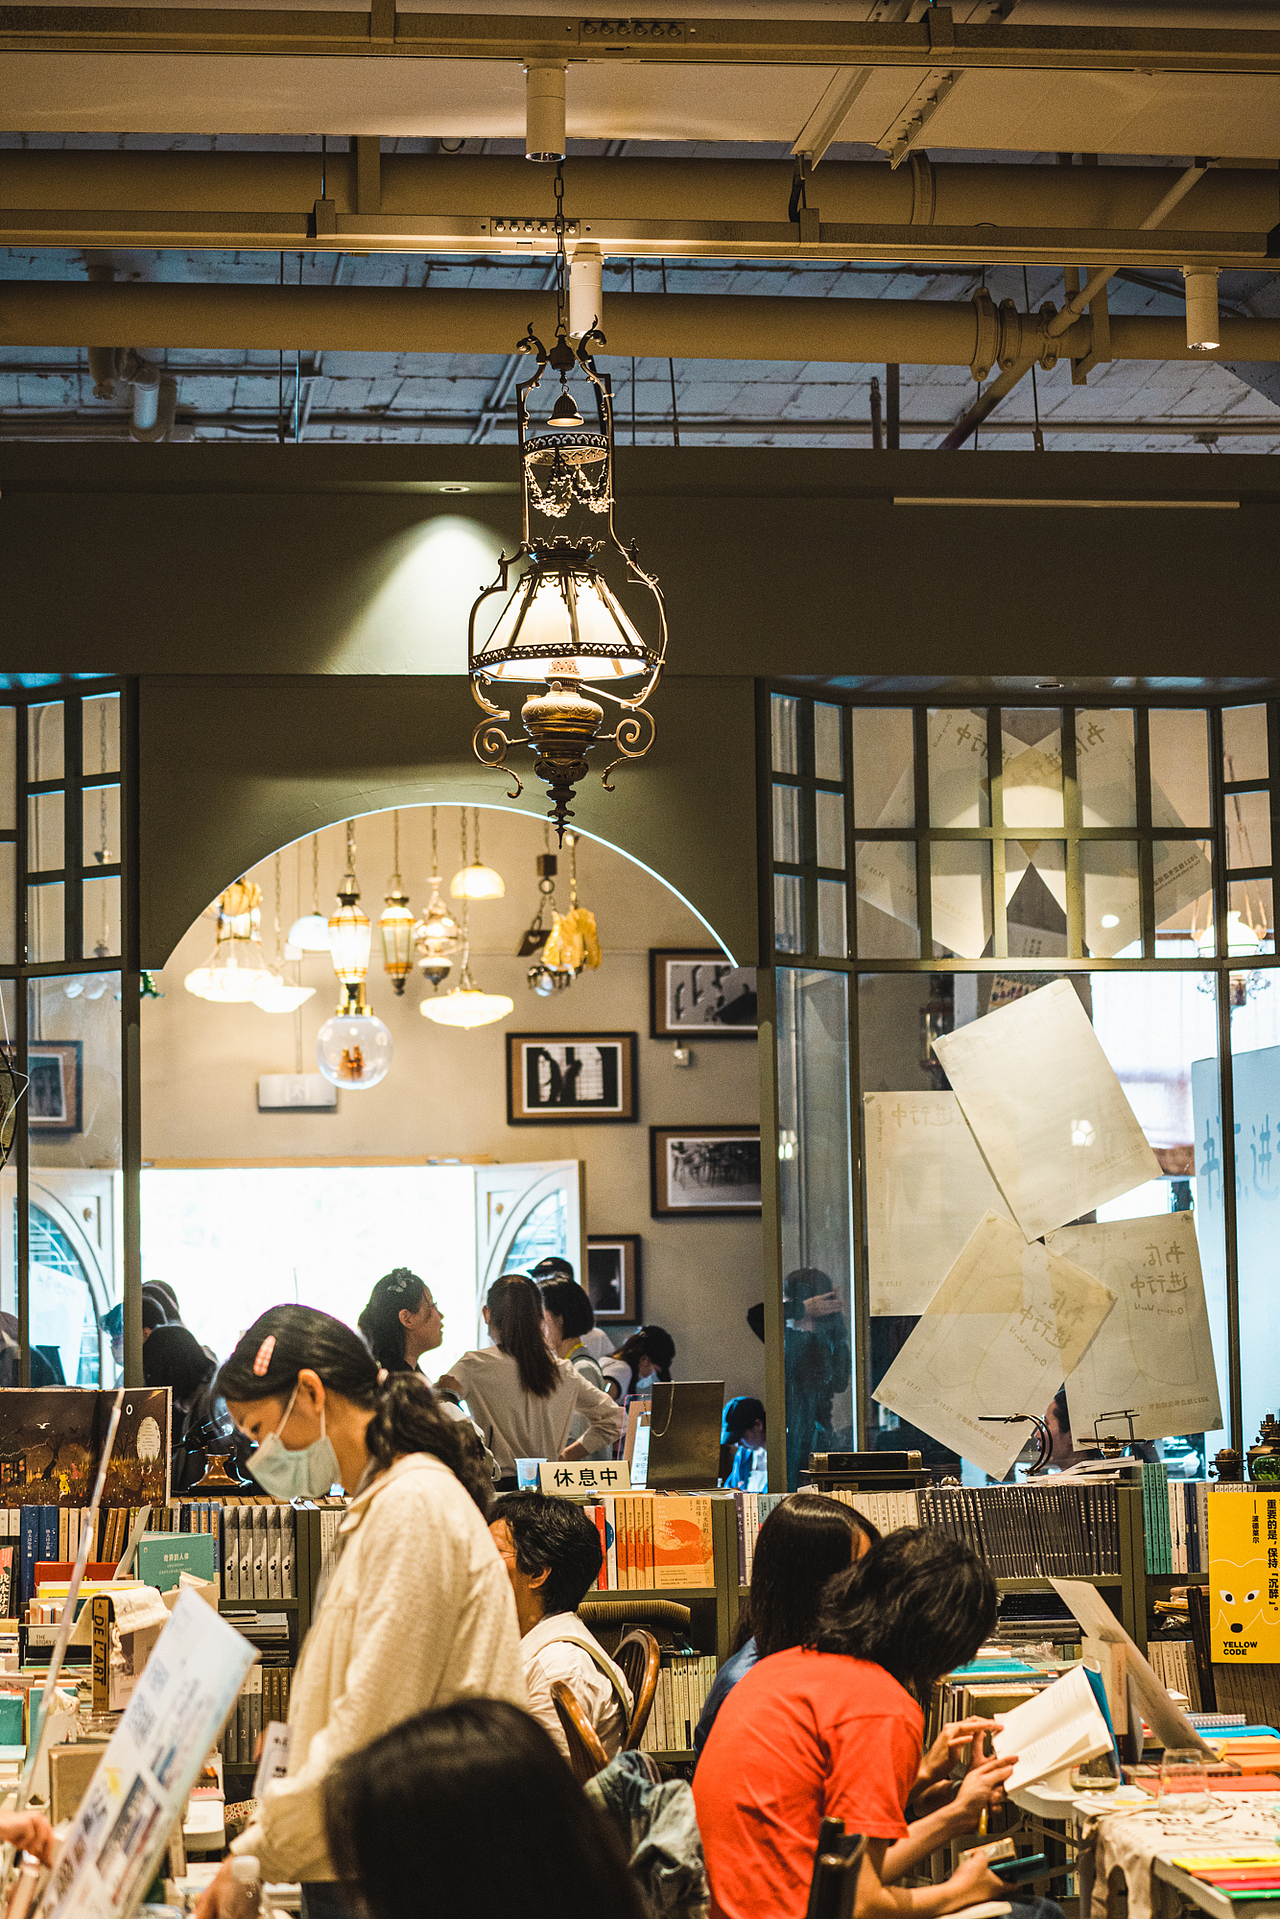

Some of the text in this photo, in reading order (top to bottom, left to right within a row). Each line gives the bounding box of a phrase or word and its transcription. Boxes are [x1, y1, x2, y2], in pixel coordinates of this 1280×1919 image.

[553, 1468, 618, 1487] 休息中
[94, 1615, 105, 1635] DE
[1223, 1641, 1258, 1649] YELLOW
[94, 1640, 106, 1686] L'ART
